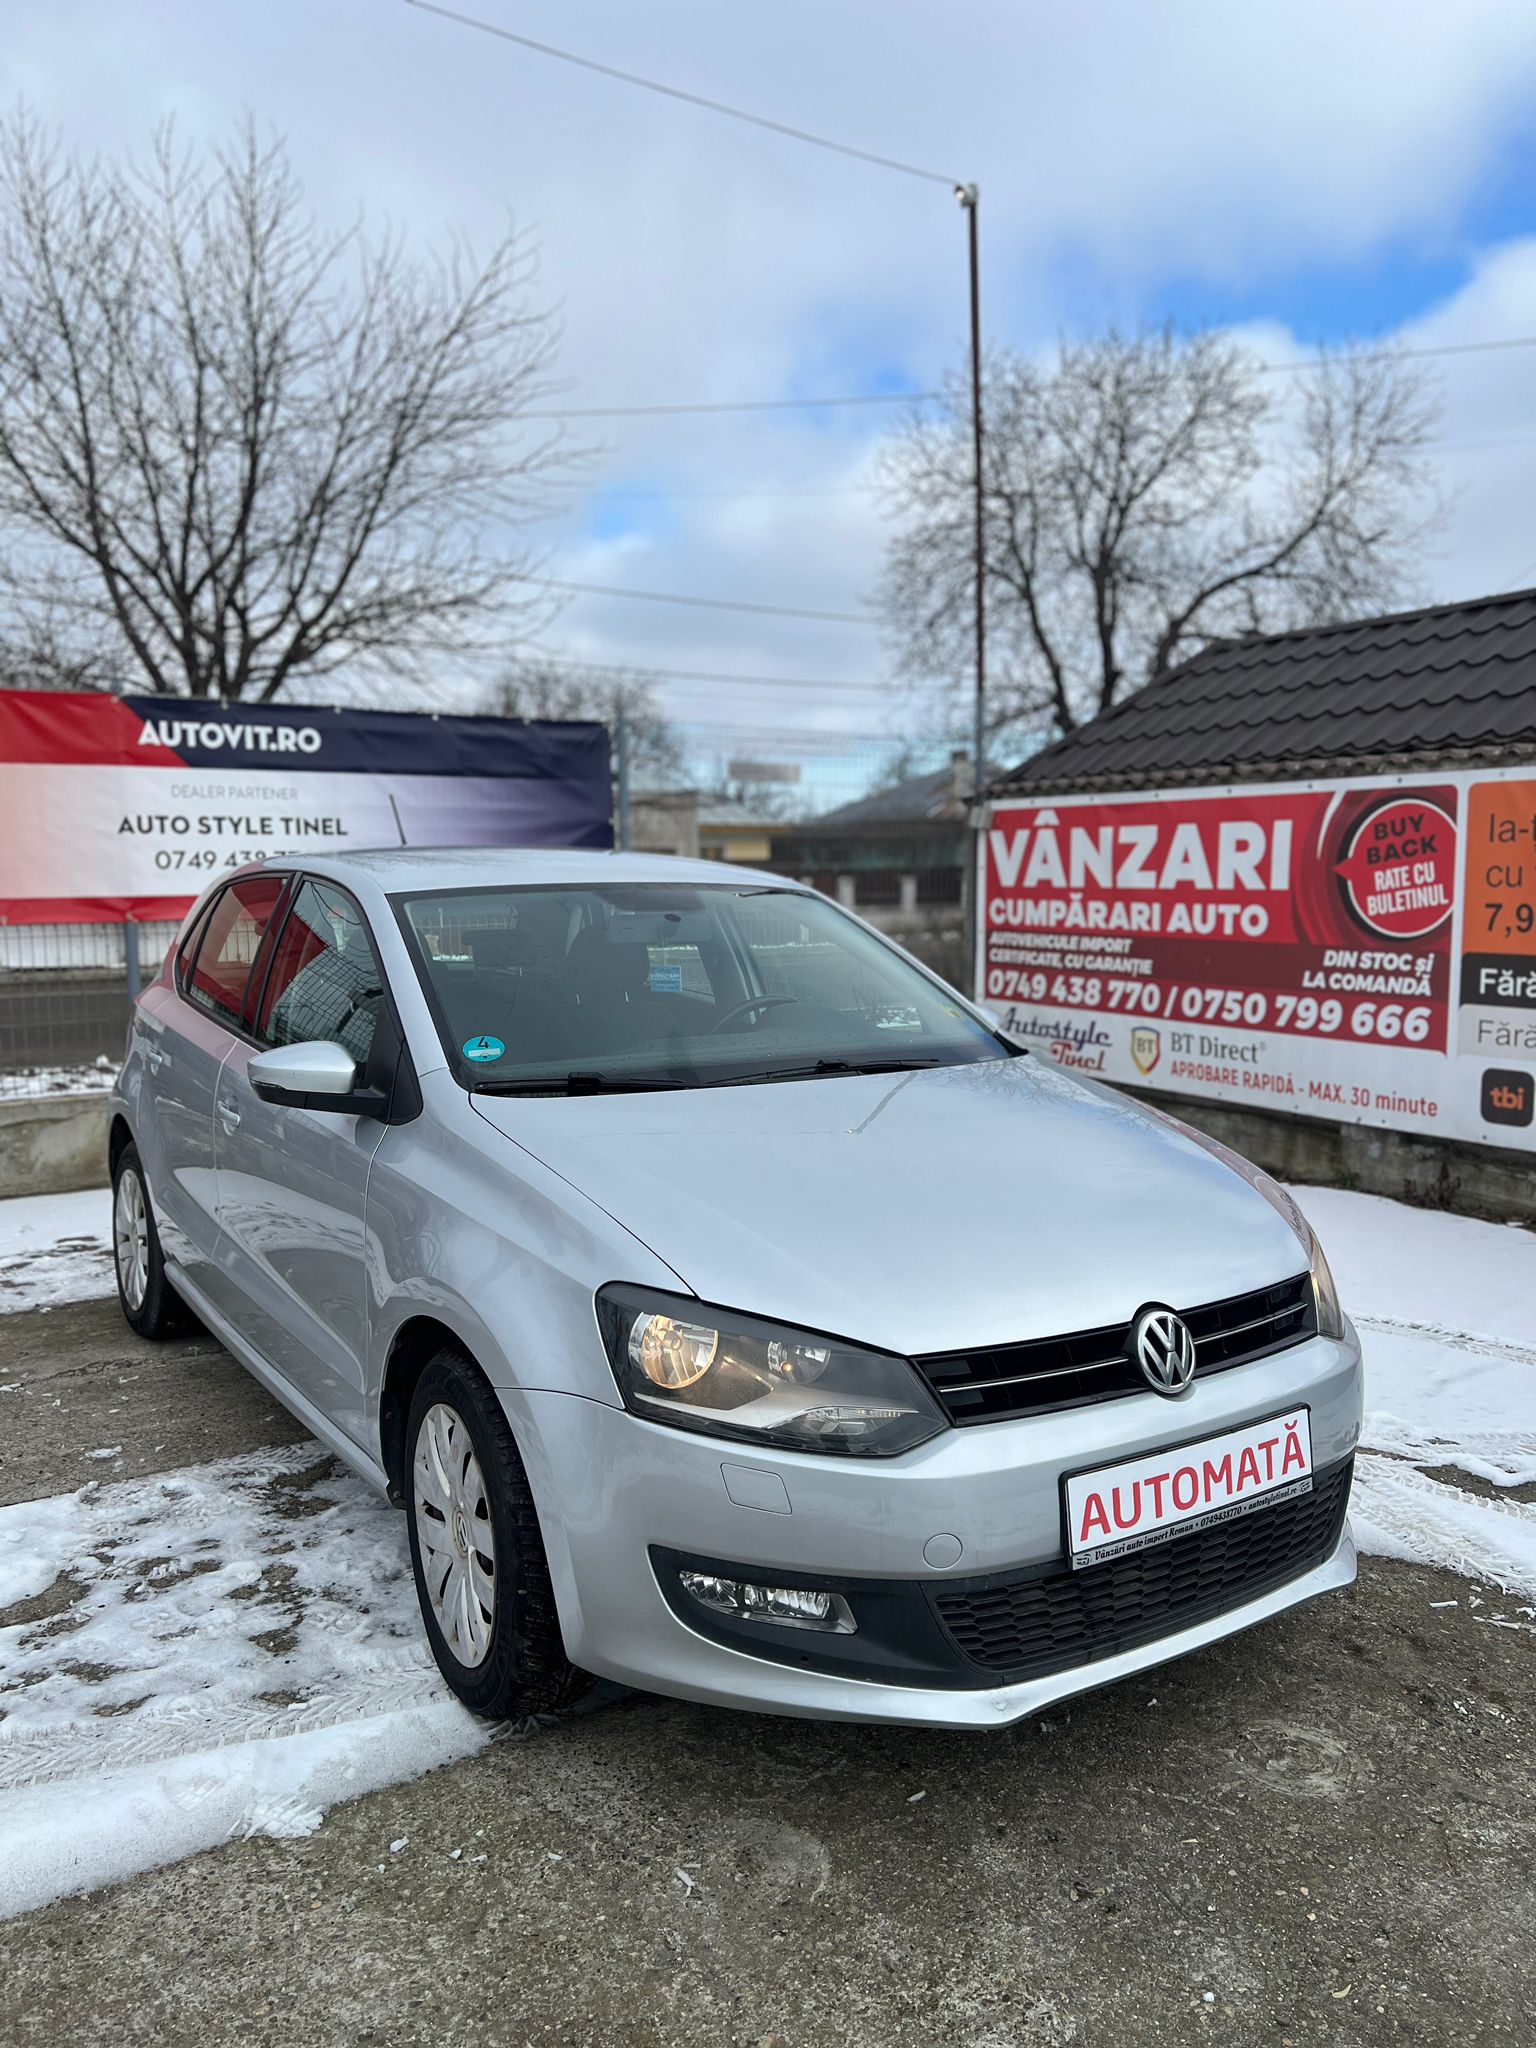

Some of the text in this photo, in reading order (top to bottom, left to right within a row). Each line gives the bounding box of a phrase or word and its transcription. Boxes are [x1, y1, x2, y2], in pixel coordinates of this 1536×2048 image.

[137, 718, 322, 753] AUTOVIT.RO
[171, 784, 298, 800] DEALER PARTENER
[118, 815, 348, 836] AUTO STYLE TINEL
[1373, 814, 1425, 841] BUY
[155, 851, 217, 870] 0749
[989, 809, 1293, 890] VÂNZARI
[1366, 834, 1438, 865] BACK
[1374, 861, 1436, 892] RATE CU
[1486, 865, 1522, 888] cu
[1366, 884, 1449, 917] BULETINUL
[989, 892, 1269, 937] CUMPĂRARI AUTO
[1079, 934, 1133, 954] IMPORT
[1064, 952, 1084, 970] CU
[1323, 949, 1358, 968] DIN
[1359, 951, 1413, 971] STOC
[1302, 970, 1431, 996] LA COMANDĂ
[988, 969, 1047, 1000] 0749
[1051, 975, 1102, 1006] 438
[1107, 980, 1161, 1013] 770
[1181, 986, 1267, 1025] 0750
[1274, 995, 1343, 1033] 799
[1351, 1002, 1432, 1042] 666
[478, 1036, 489, 1048] 4
[1136, 1037, 1155, 1053] BT
[1171, 1032, 1194, 1054] BT
[1170, 1060, 1239, 1086] APROBARE
[1308, 1080, 1346, 1104] MAX.
[1350, 1086, 1370, 1107] 30
[1376, 1090, 1438, 1117] minute
[1490, 1086, 1525, 1110] tbi
[1080, 1419, 1306, 1543] AUTOMATĂ
[1126, 1540, 1143, 1552] auto
[1144, 1531, 1168, 1545] import
[1169, 1523, 1194, 1537] Roman
